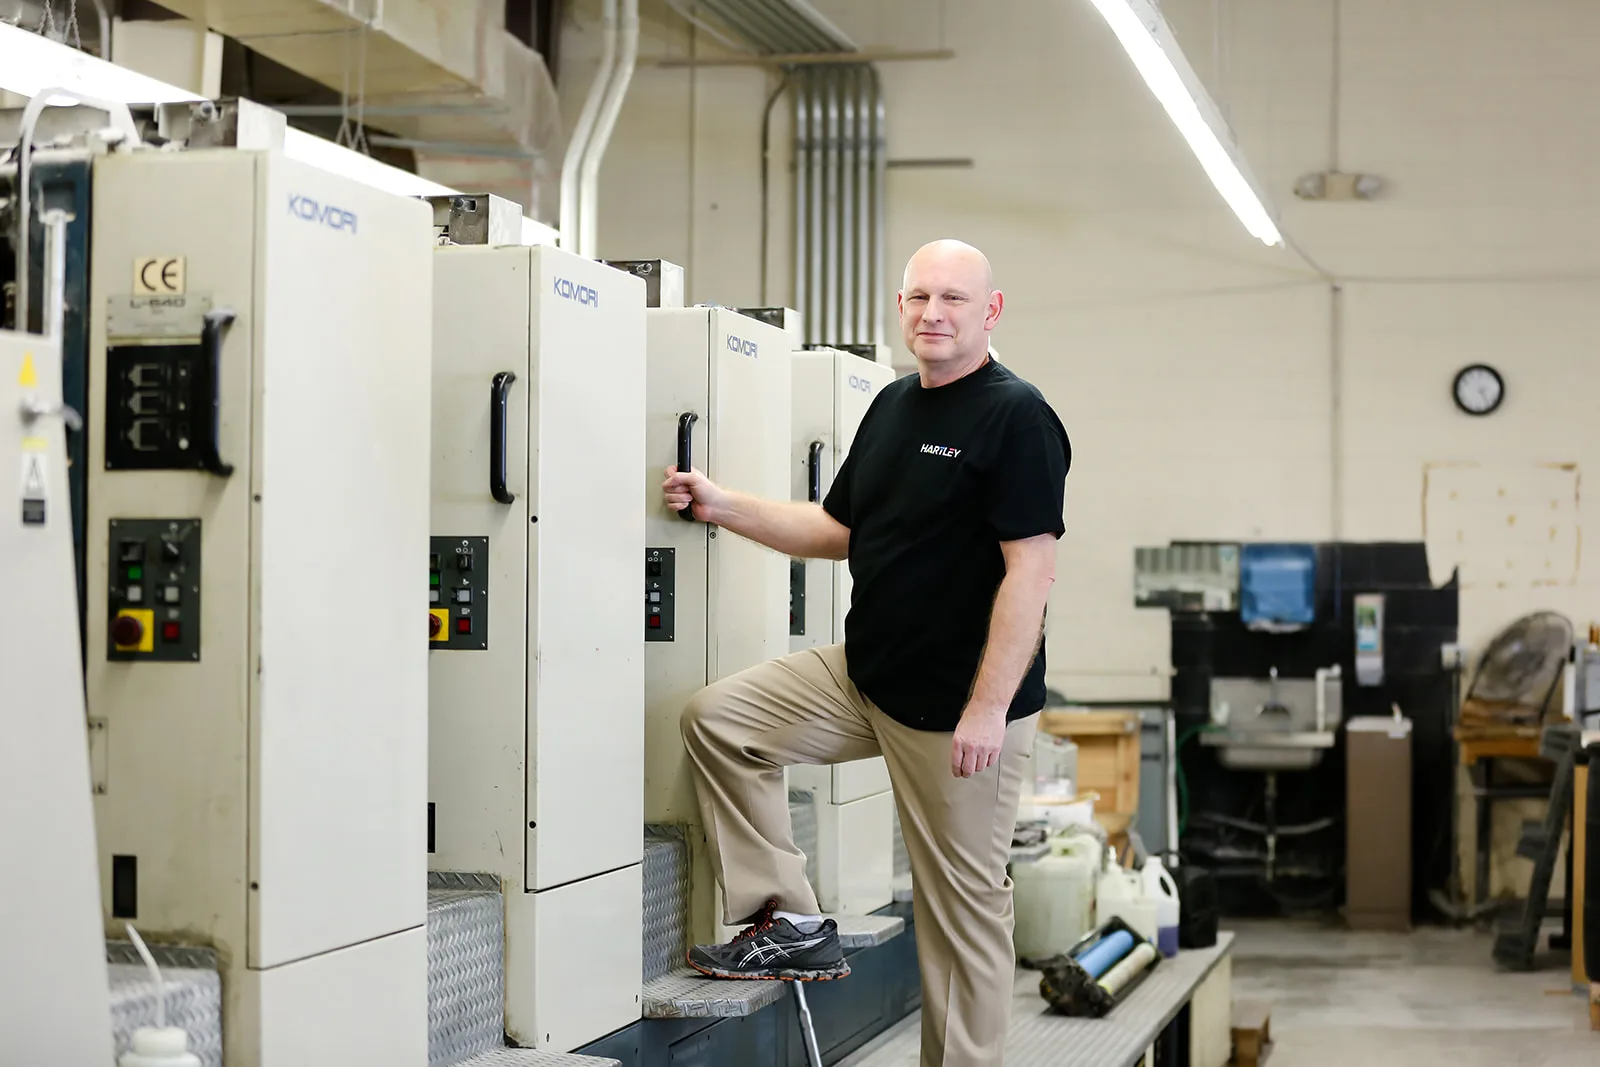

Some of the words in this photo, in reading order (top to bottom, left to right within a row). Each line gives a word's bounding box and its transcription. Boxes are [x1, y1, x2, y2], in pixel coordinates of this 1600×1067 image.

[287, 193, 358, 235] KOMORI
[141, 259, 177, 291] CE
[553, 275, 599, 308] KOMORI
[726, 333, 758, 358] KOMORI
[920, 443, 962, 458] HARTLEY
